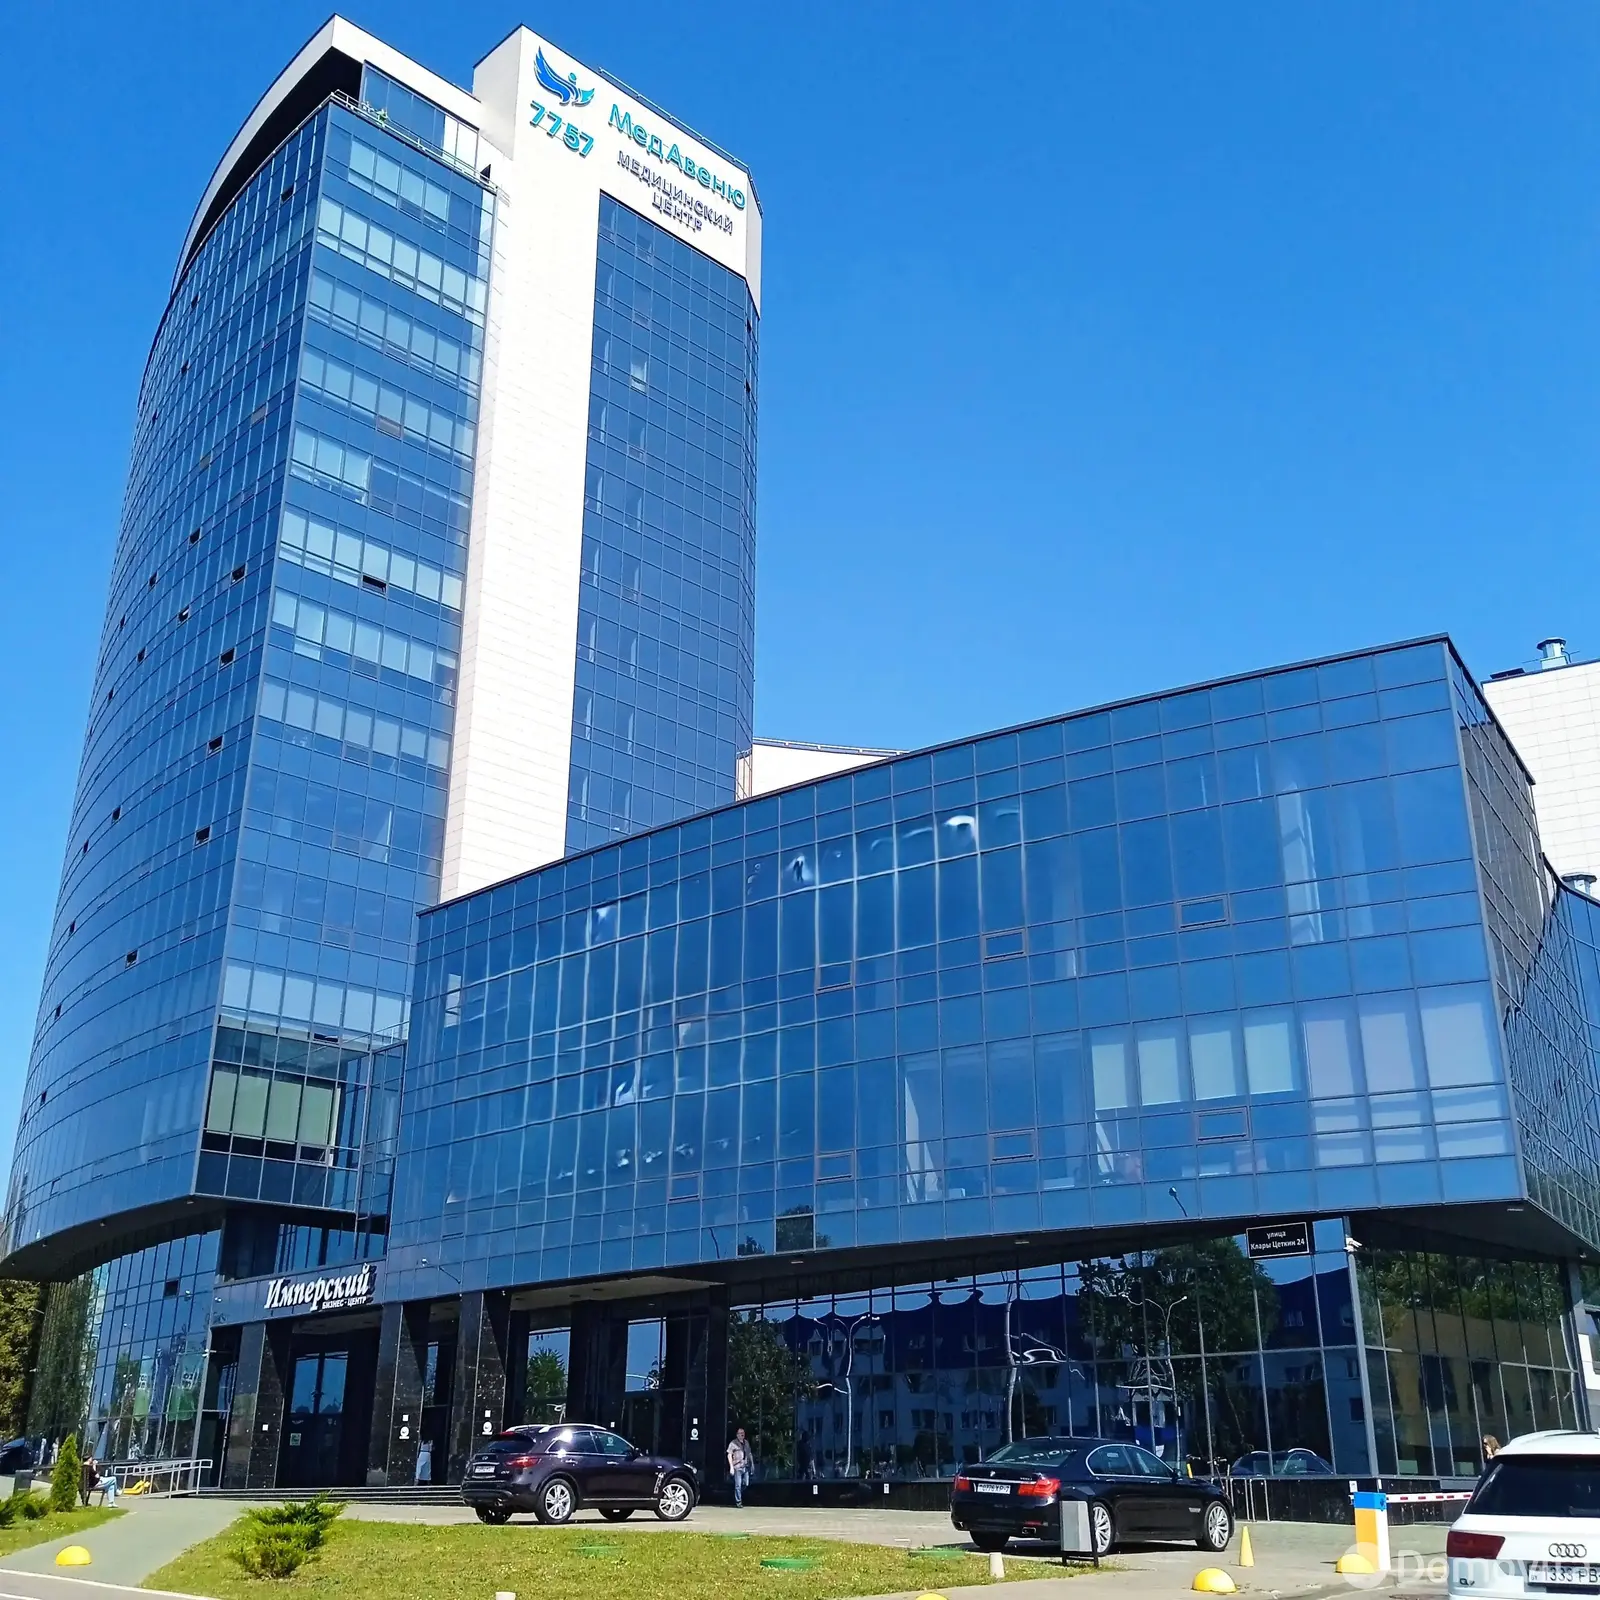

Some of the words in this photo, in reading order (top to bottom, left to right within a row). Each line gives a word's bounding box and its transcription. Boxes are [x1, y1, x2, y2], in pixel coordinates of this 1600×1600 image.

[529, 99, 594, 159] 7757
[617, 151, 733, 236] МЕДИЦИНСКИЙ
[652, 192, 702, 232] ЦЕНТР
[1266, 1231, 1286, 1240] улица
[1272, 1240, 1296, 1249] Цеткин
[1296, 1238, 1305, 1246] 24
[264, 1262, 371, 1312] Имперский
